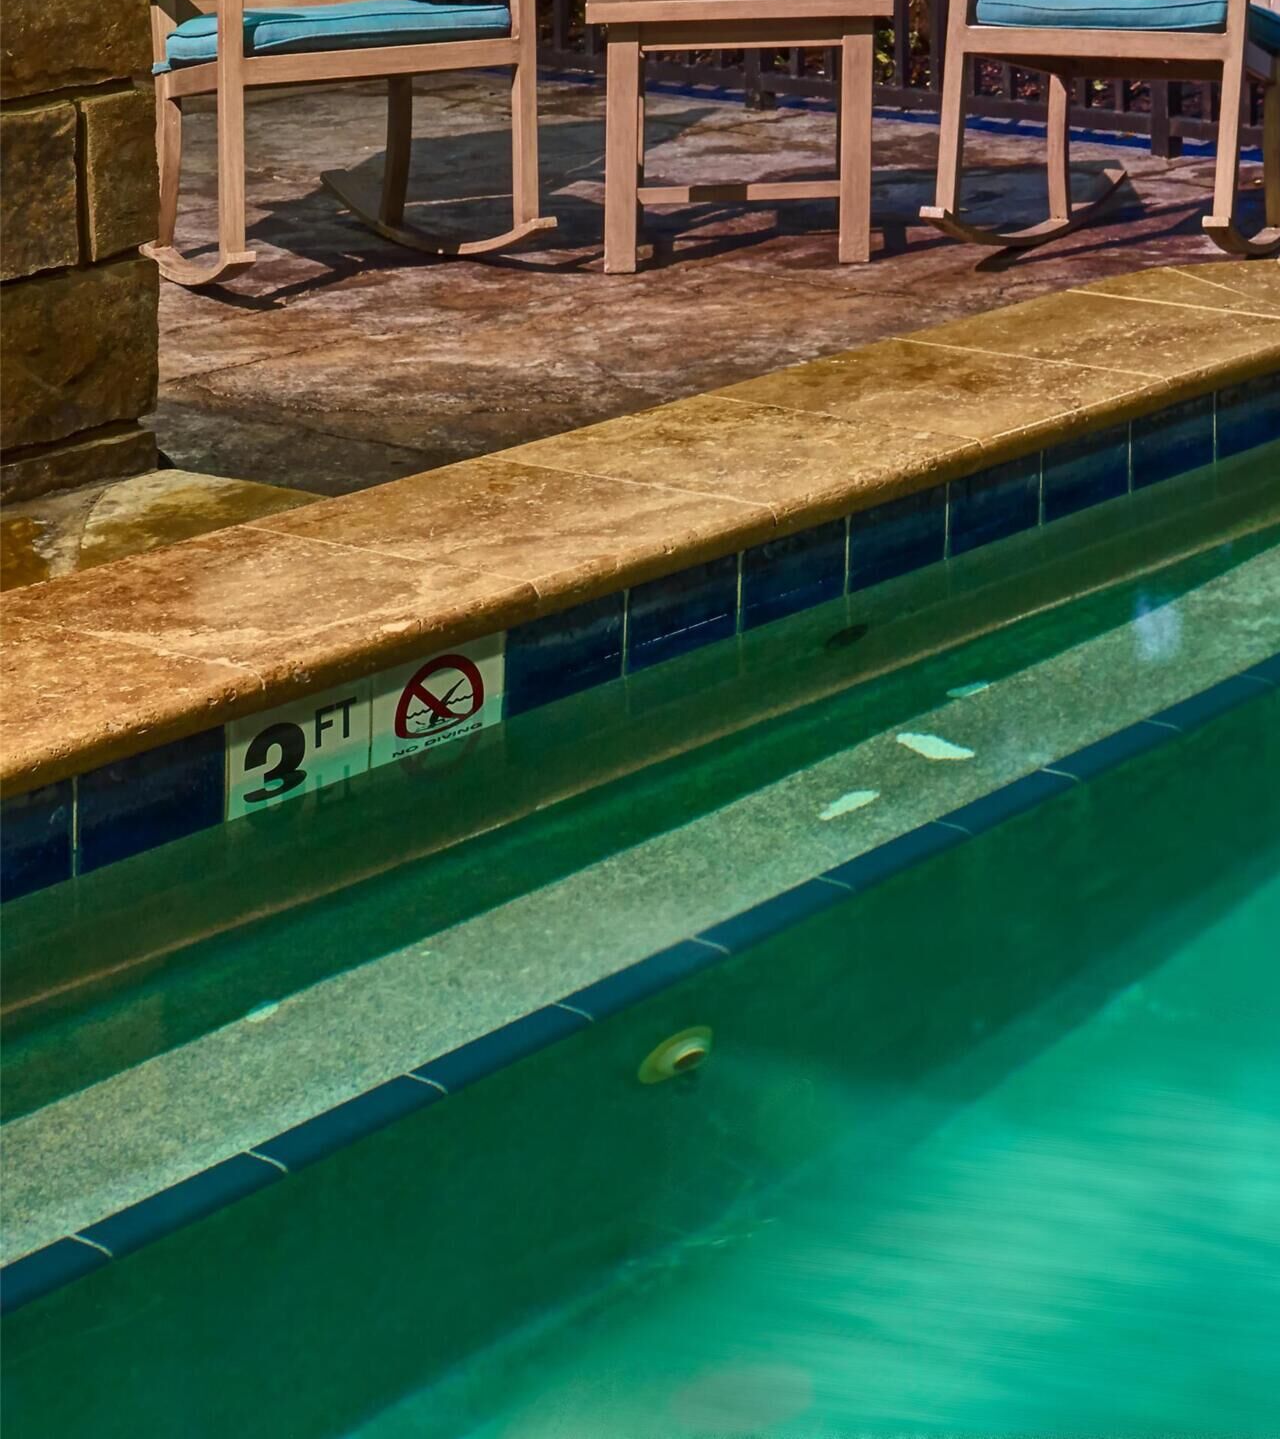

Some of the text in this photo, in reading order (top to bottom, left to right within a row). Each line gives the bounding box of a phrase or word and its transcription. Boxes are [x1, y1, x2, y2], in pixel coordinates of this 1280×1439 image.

[243, 696, 357, 803] 3 FT
[392, 722, 483, 758] NO DIVING
